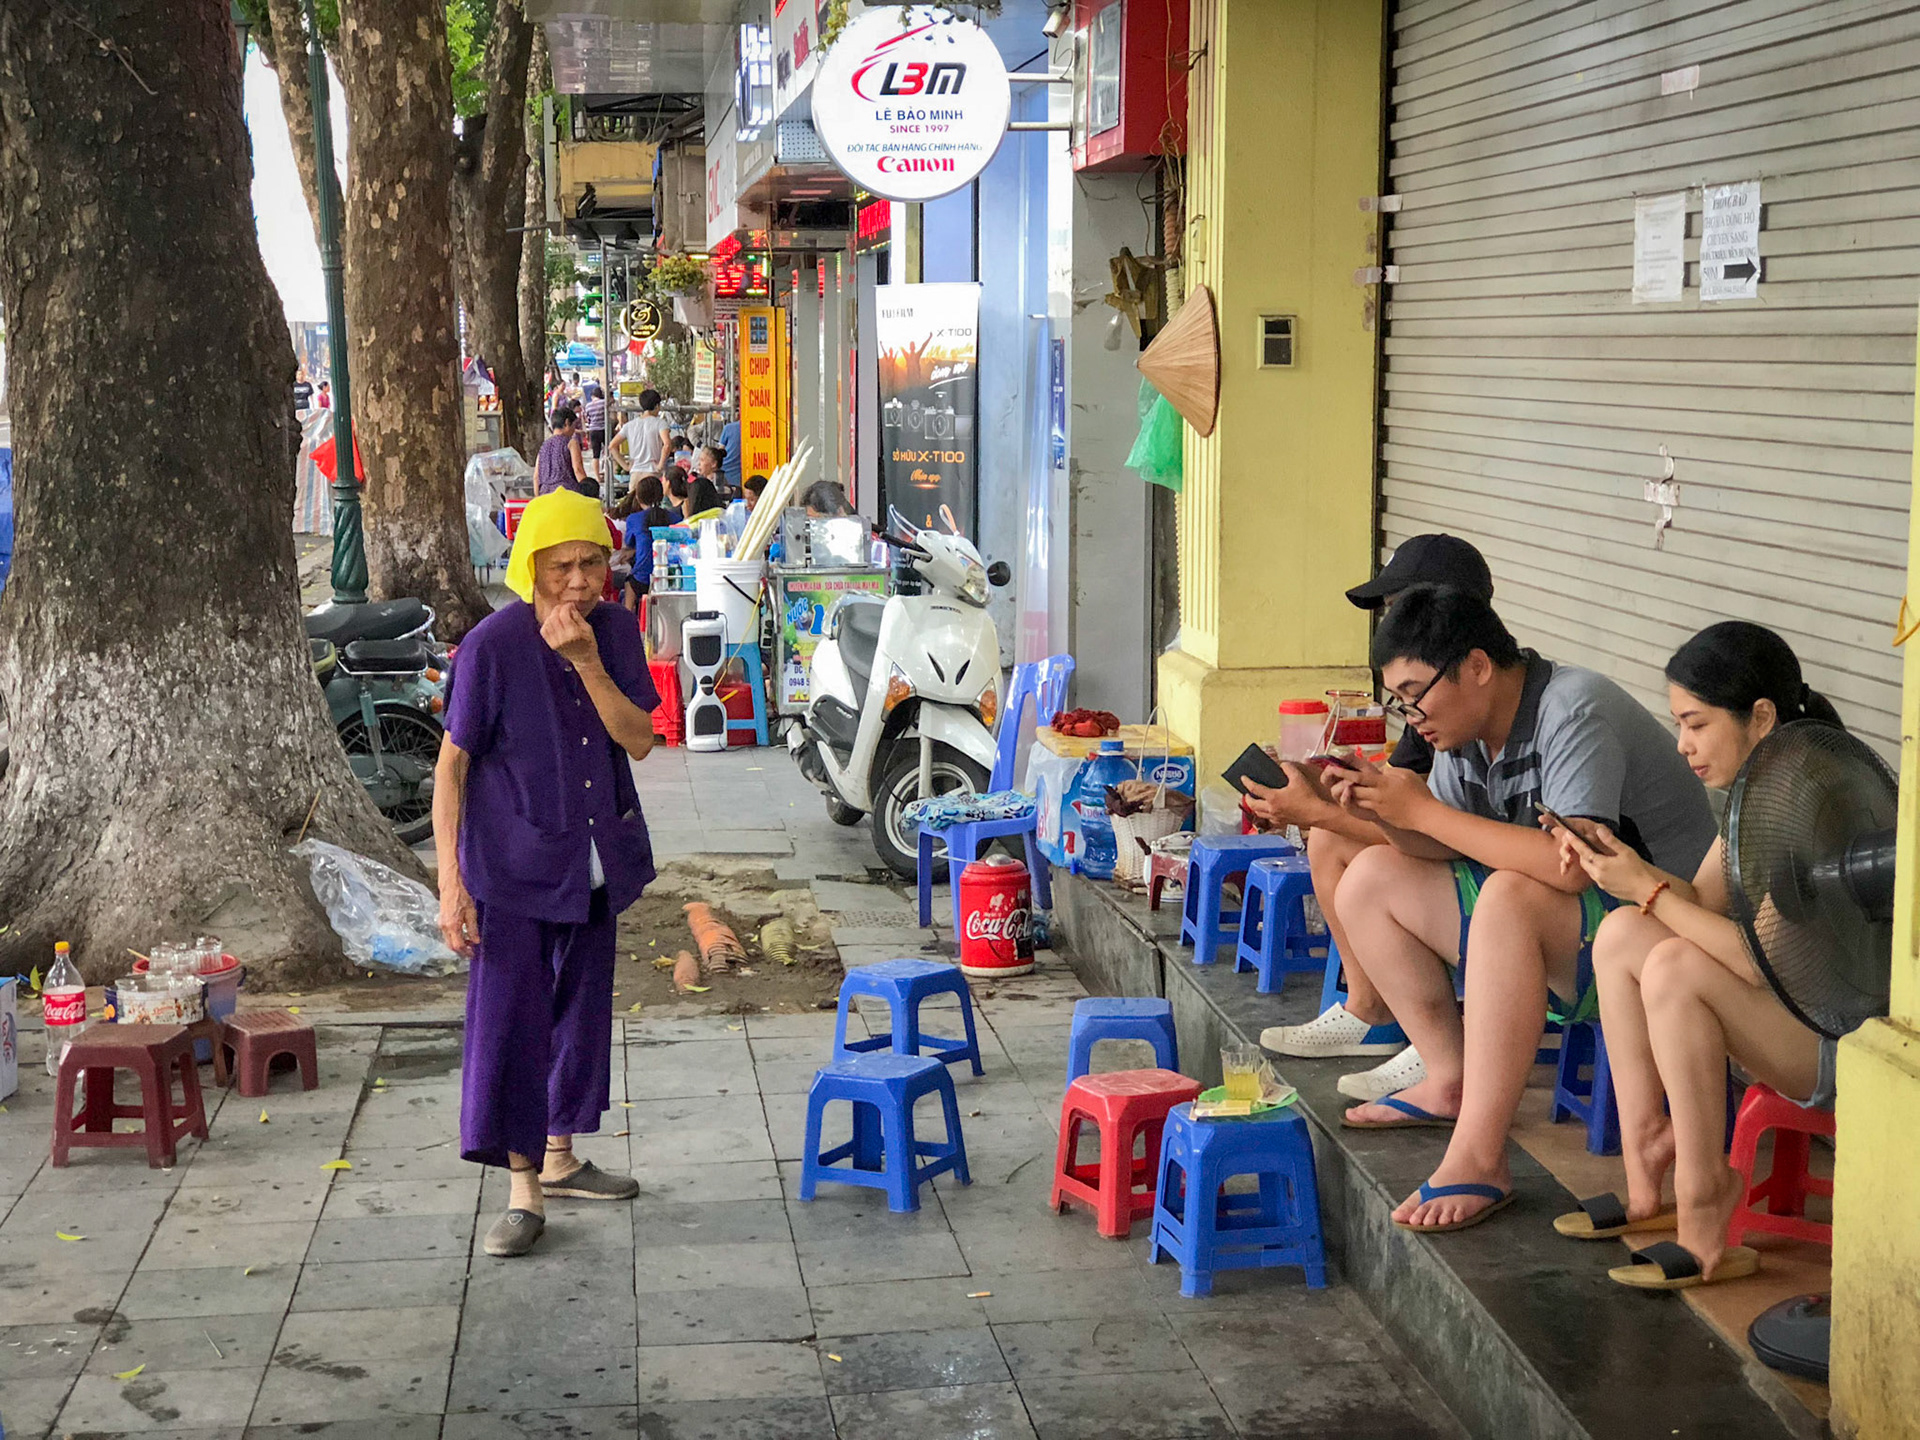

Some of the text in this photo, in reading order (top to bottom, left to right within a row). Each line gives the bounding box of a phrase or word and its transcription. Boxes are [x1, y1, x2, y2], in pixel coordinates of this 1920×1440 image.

[879, 62, 967, 95] LBM
[875, 106, 963, 121] LÊ BẢO MINH
[890, 124, 949, 133] SINCE 1997
[877, 155, 955, 173] Canon
[749, 357, 770, 379] CHỤP
[750, 421, 771, 438] DUNG
[917, 450, 965, 463] X-T100
[926, 514, 932, 528] &
